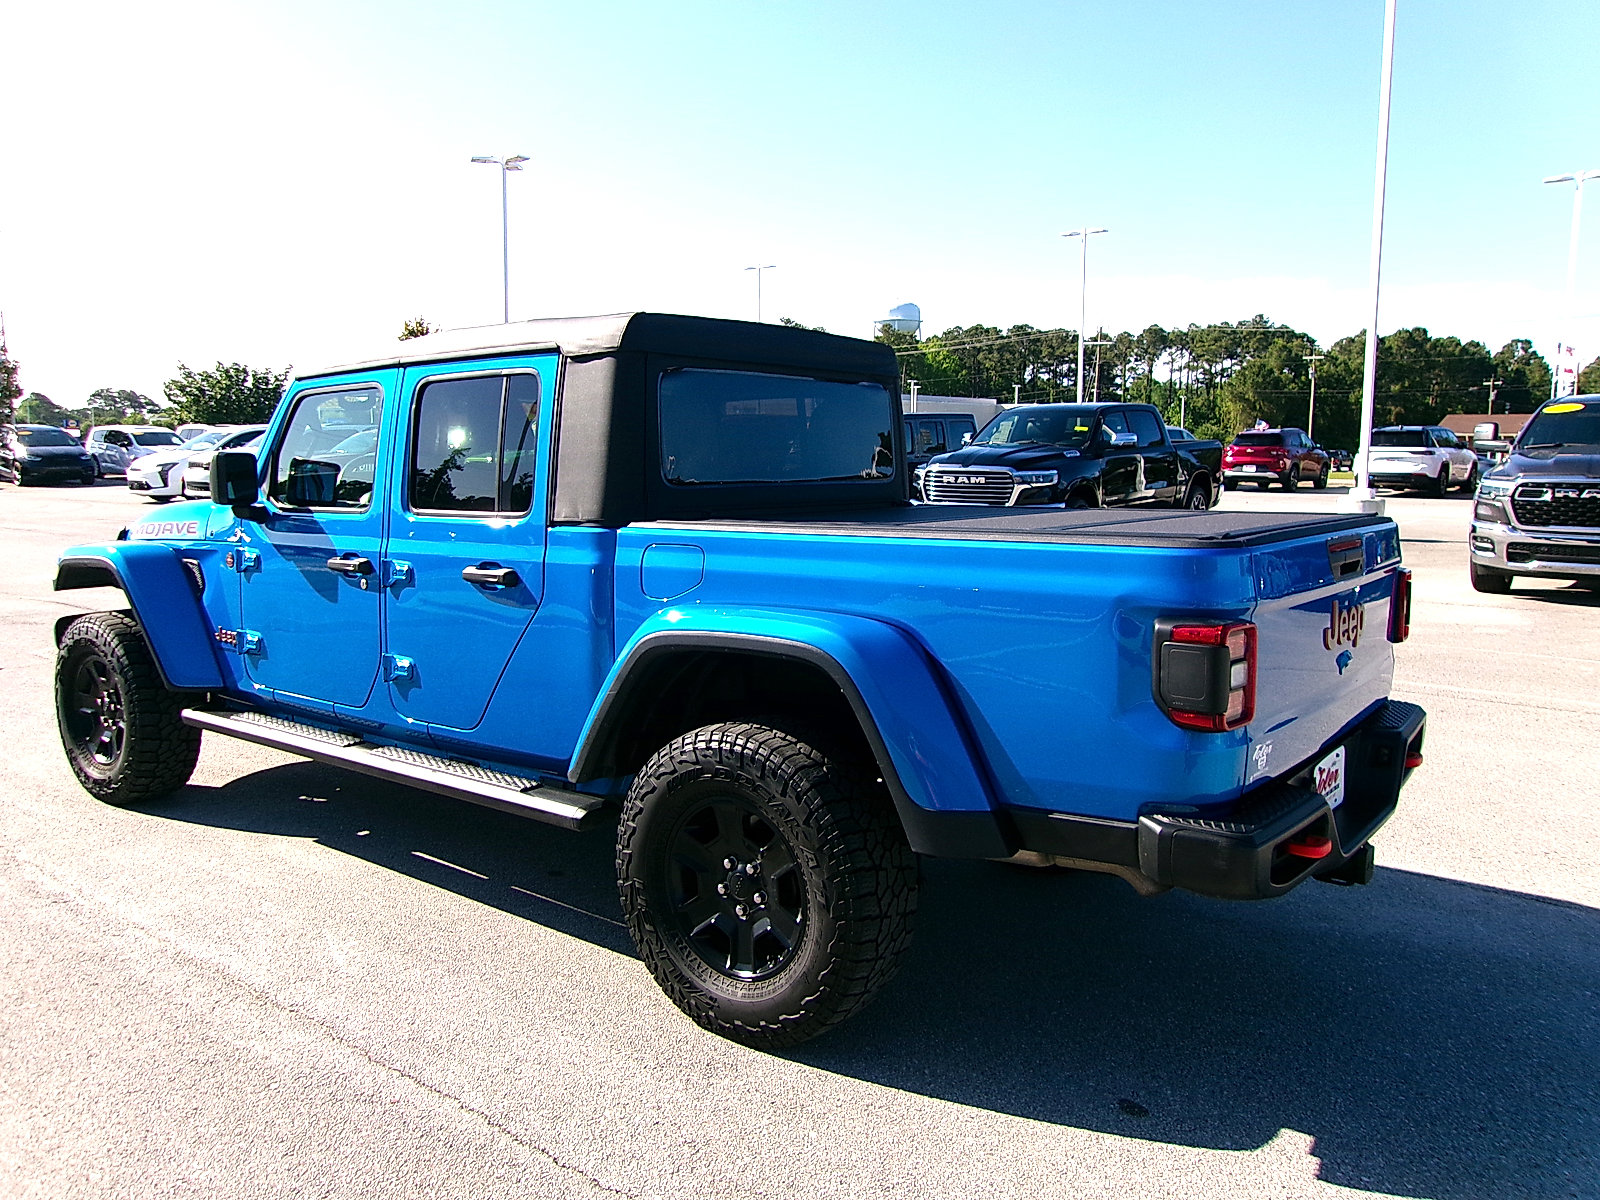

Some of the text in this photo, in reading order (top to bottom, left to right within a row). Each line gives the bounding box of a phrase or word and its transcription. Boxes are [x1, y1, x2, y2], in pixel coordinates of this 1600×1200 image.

[943, 476, 986, 484] RAM
[1555, 488, 1600, 498] RA
[1323, 600, 1366, 650] Jeep
